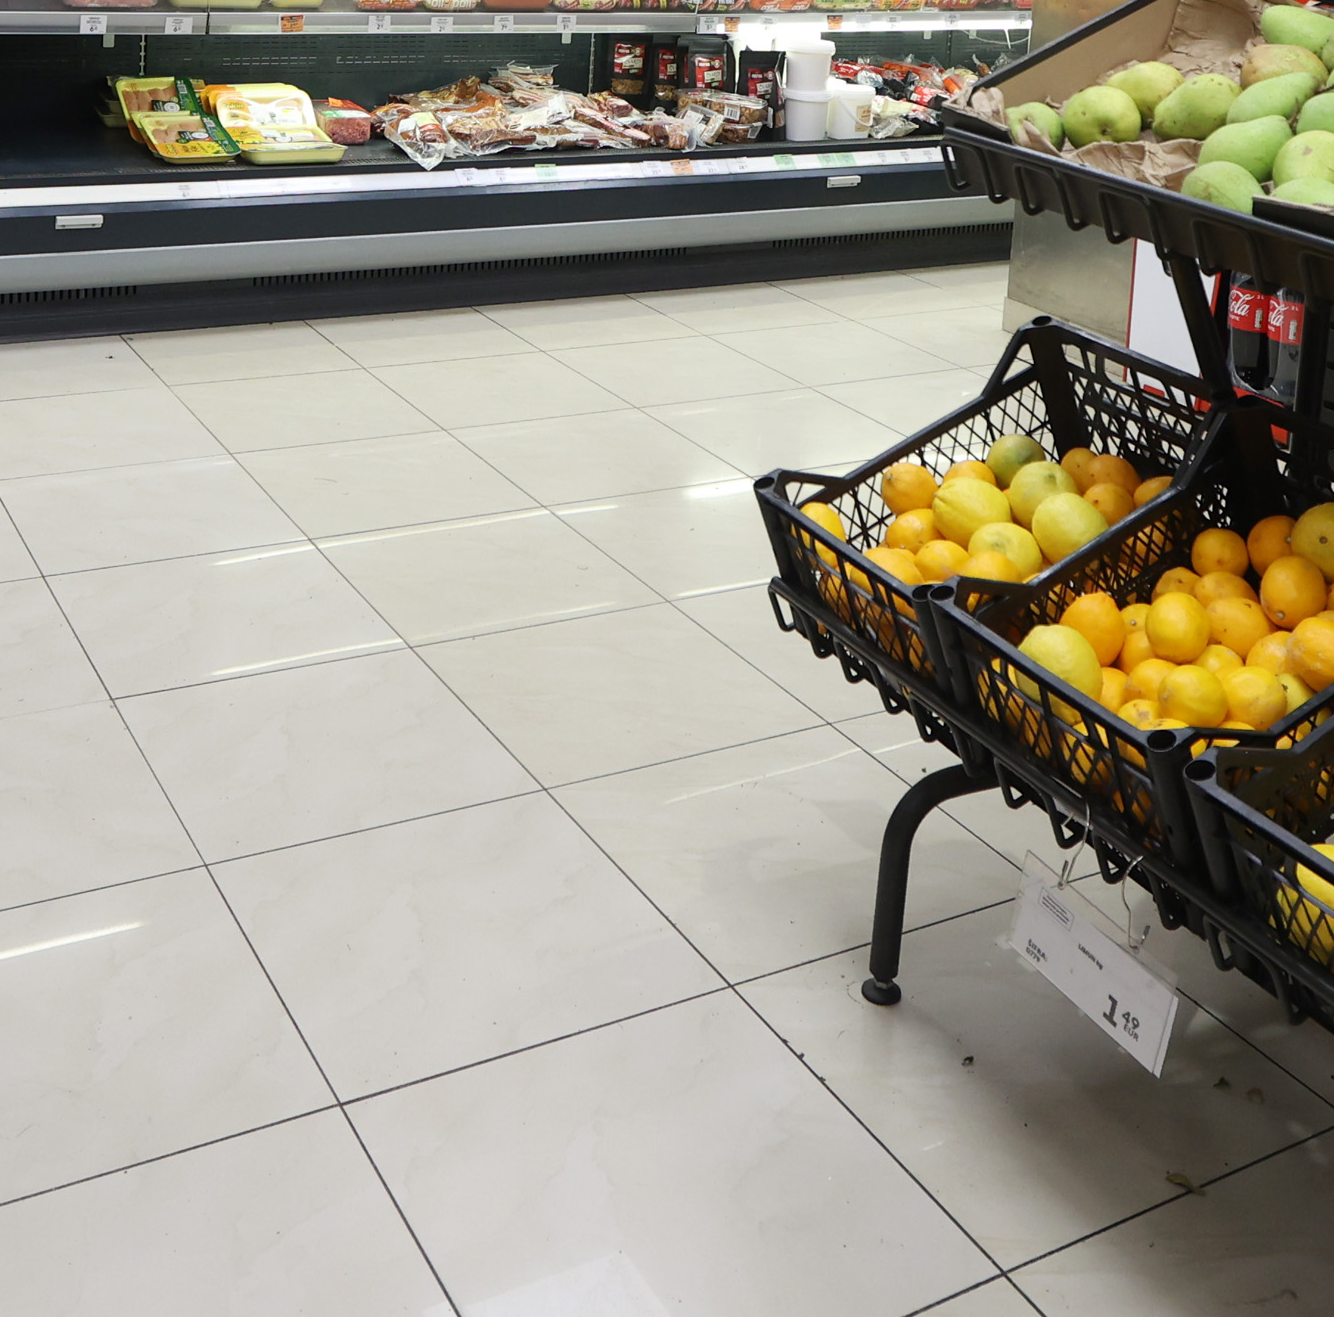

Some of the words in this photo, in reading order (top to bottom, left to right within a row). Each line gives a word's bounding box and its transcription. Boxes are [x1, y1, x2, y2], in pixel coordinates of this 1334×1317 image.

[1102, 994, 1118, 1028] 1
[1122, 1011, 1140, 1030] 49
[1123, 1023, 1139, 1042] EUR
